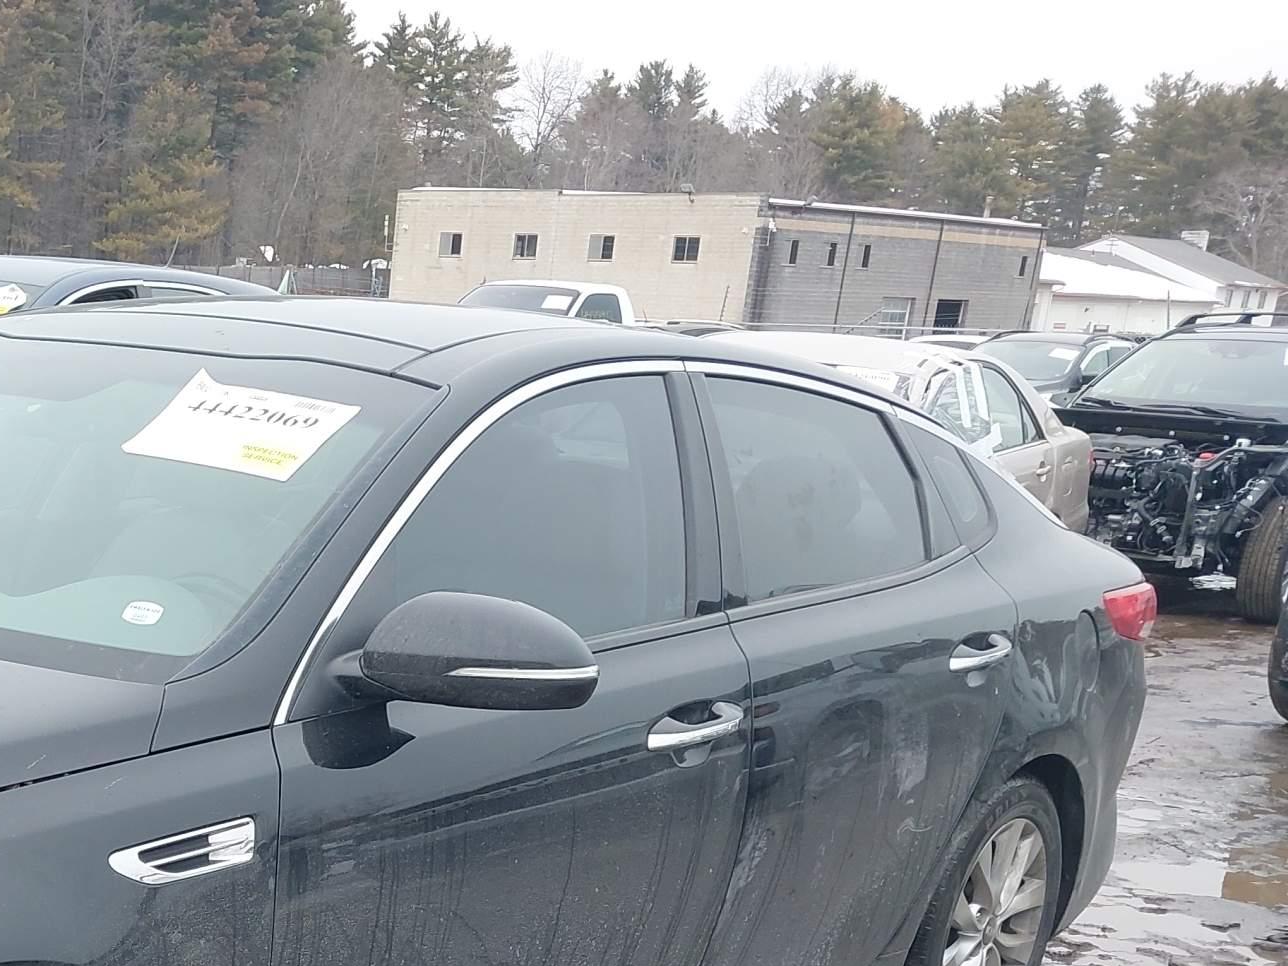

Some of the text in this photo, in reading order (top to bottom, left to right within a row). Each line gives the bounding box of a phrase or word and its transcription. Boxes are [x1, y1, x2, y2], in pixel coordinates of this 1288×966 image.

[187, 400, 320, 429] 44422069
[240, 453, 286, 466] SERVICE
[242, 445, 299, 461] INSPECTION
